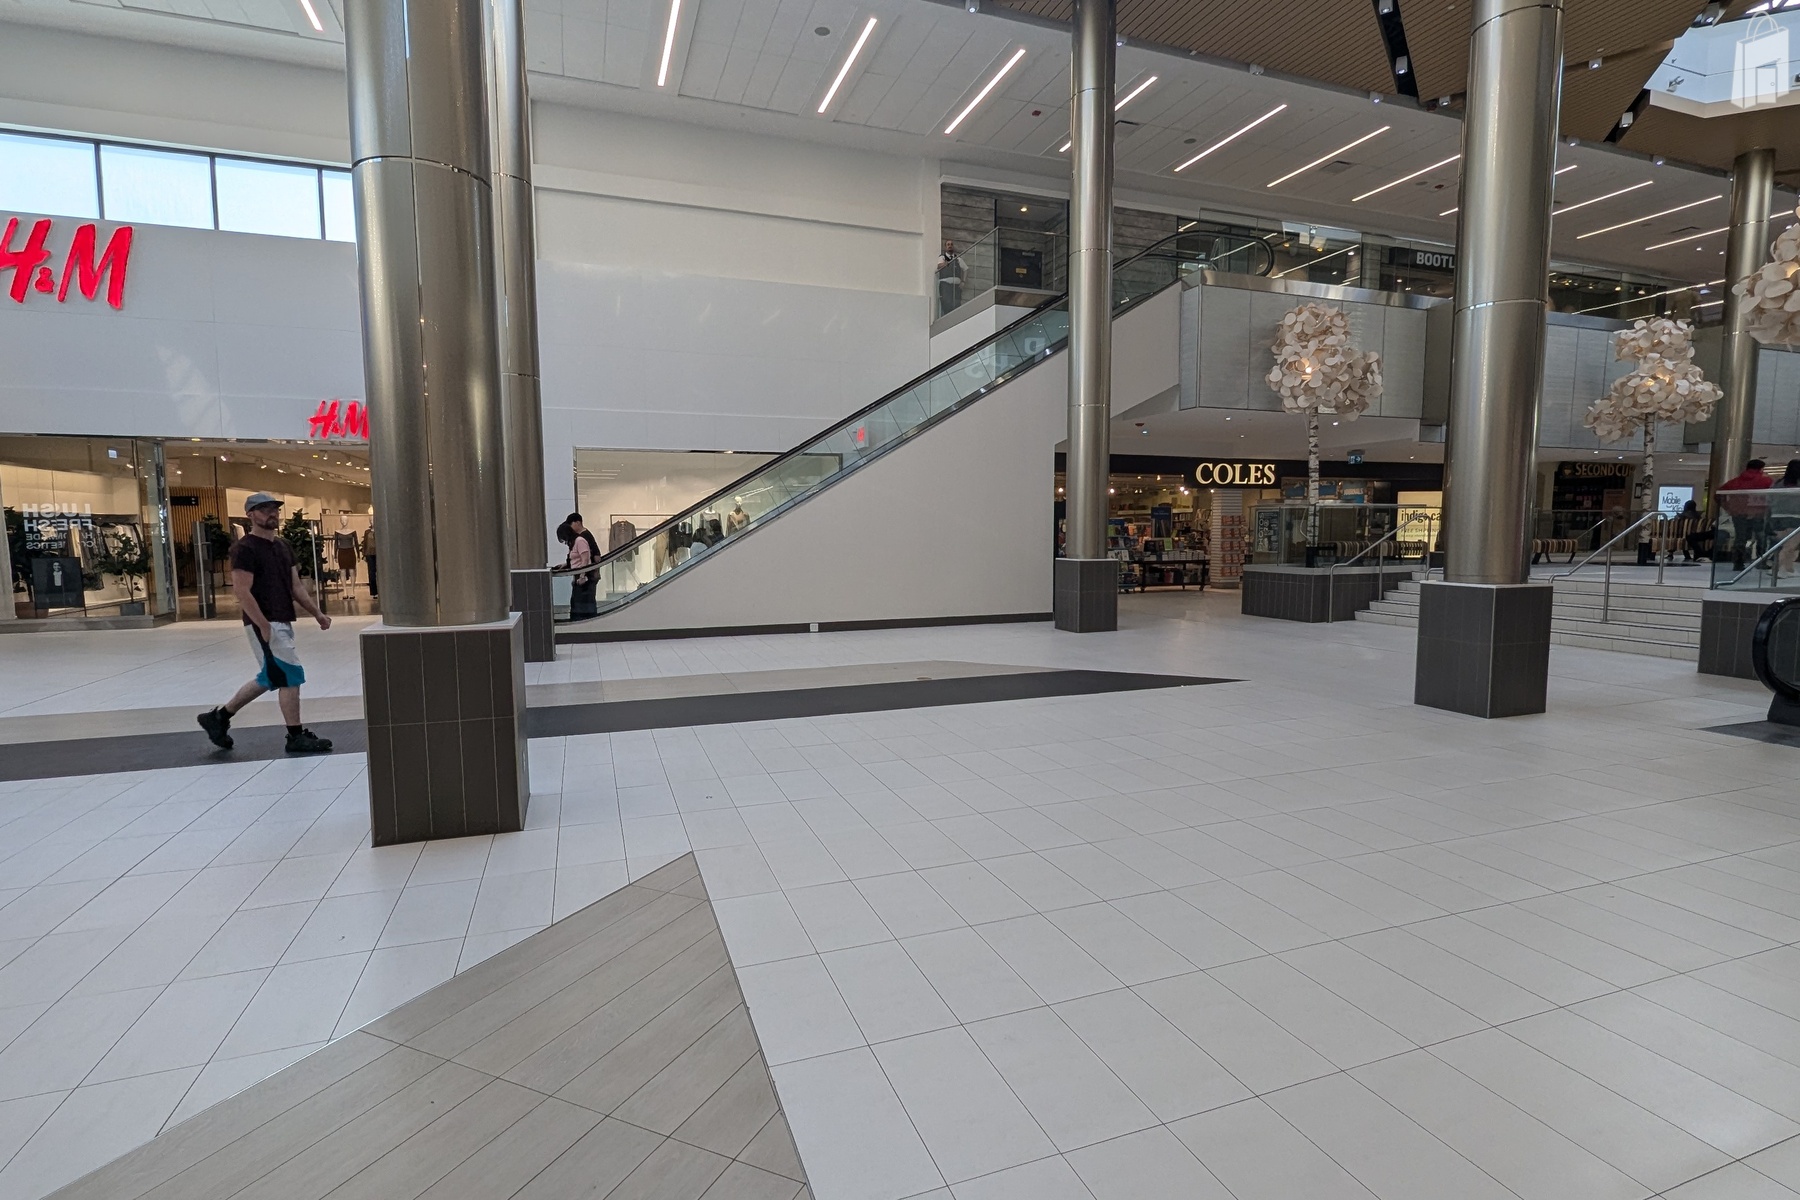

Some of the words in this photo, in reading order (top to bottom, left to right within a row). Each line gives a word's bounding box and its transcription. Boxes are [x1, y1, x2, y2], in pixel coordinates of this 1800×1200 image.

[0, 217, 134, 310] H&M
[307, 400, 369, 440] H&M
[1195, 462, 1276, 485] COLES
[1575, 463, 1615, 477] SECOND
[1662, 495, 1681, 505] Mobile
